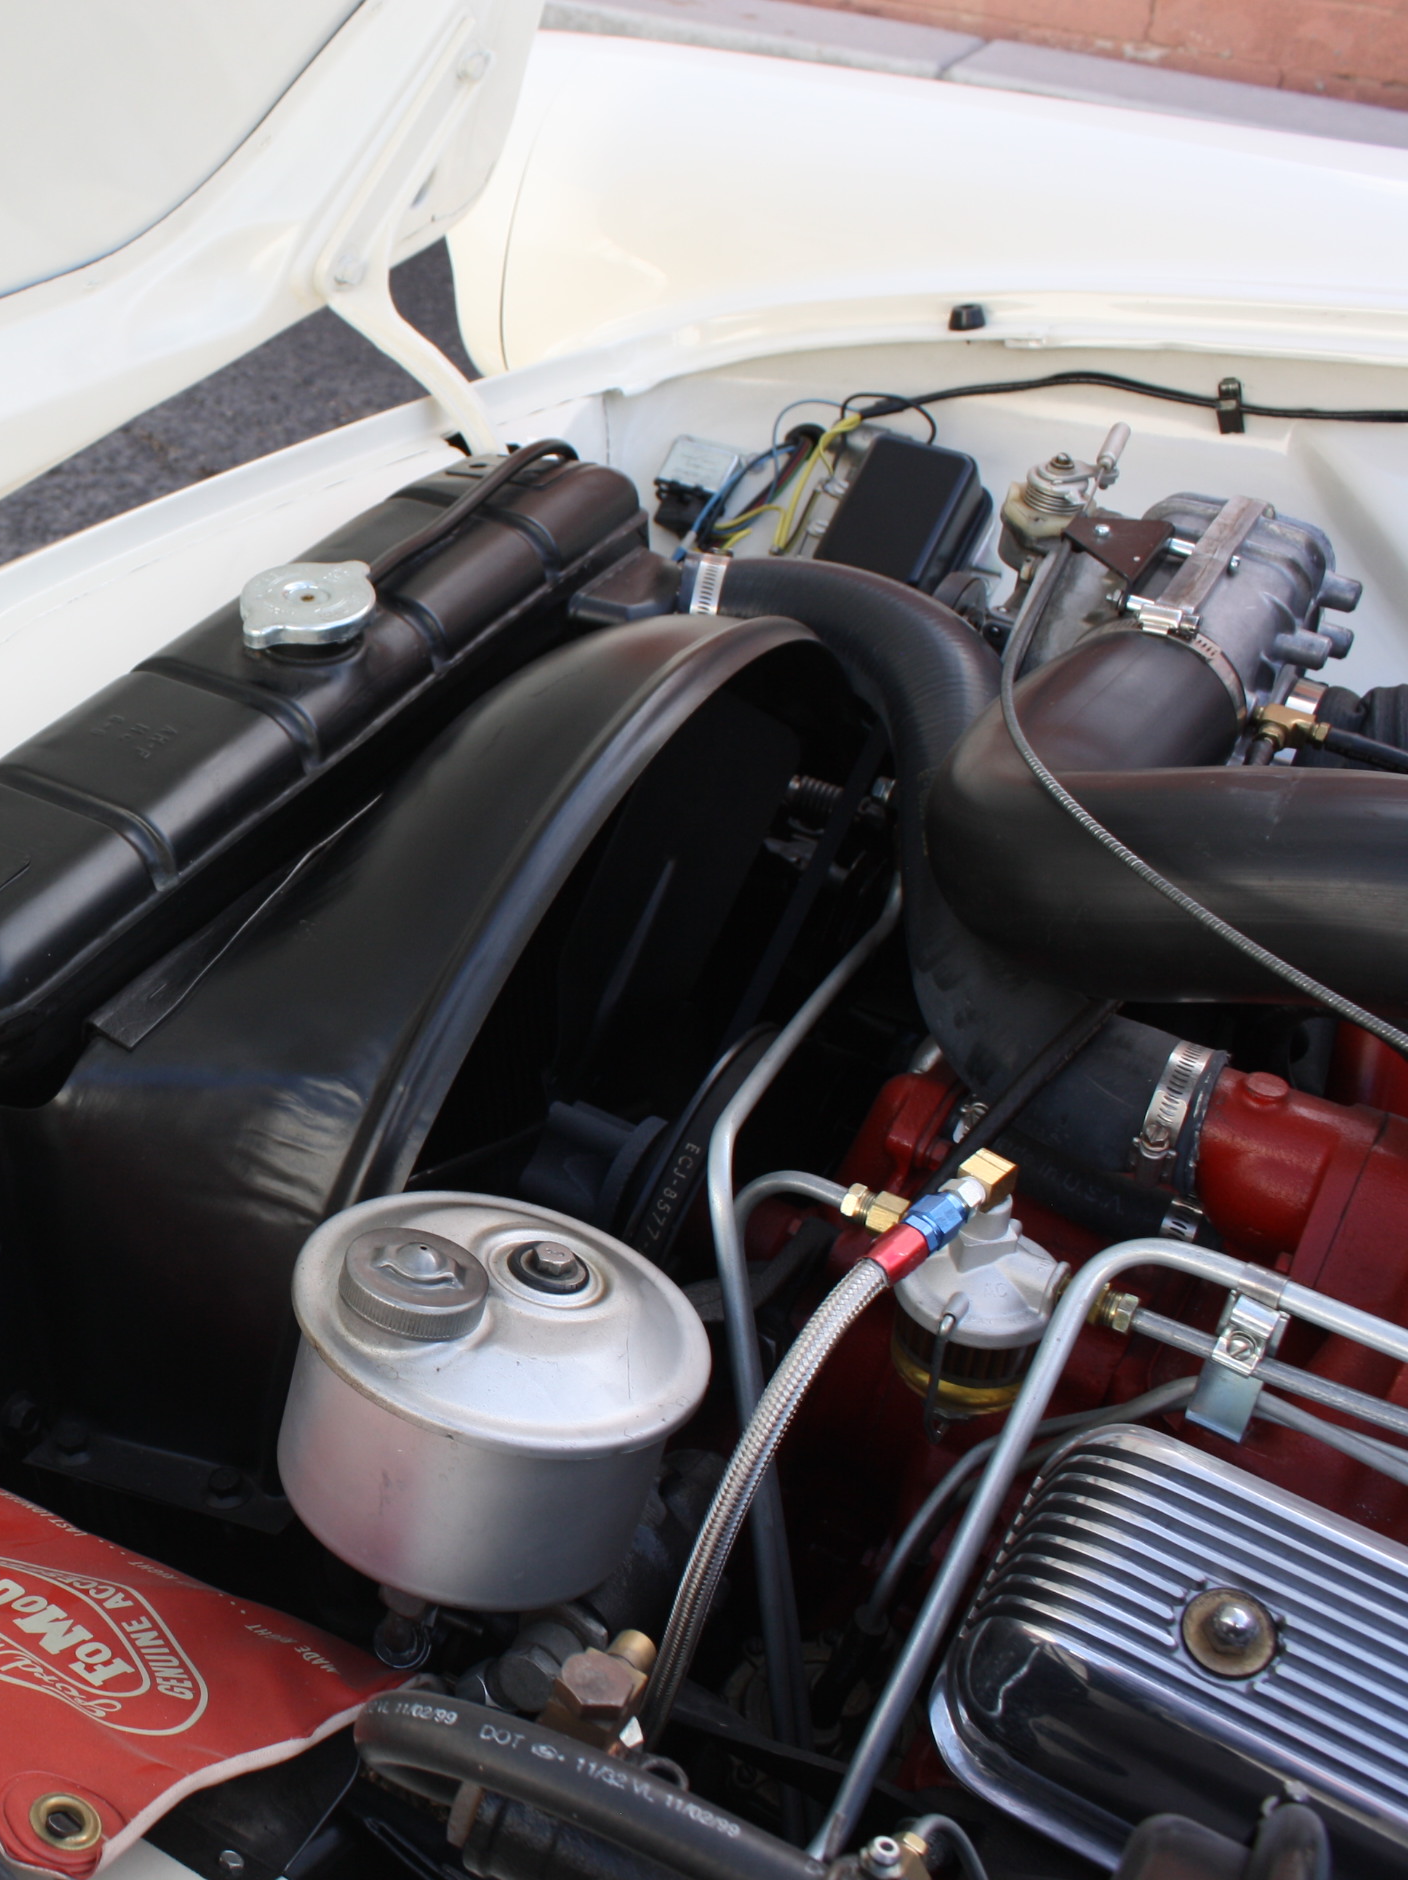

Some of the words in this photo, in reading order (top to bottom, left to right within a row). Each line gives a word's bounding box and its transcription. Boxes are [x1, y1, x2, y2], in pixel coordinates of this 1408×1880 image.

[643, 1141, 702, 1248] ECJ-8577-
[47, 1519, 88, 1536] LAST
[119, 1613, 194, 1695] GENUINE
[292, 1643, 336, 1673] MADE
[0, 1650, 122, 1720] Ford
[480, 1724, 525, 1749] DOT
